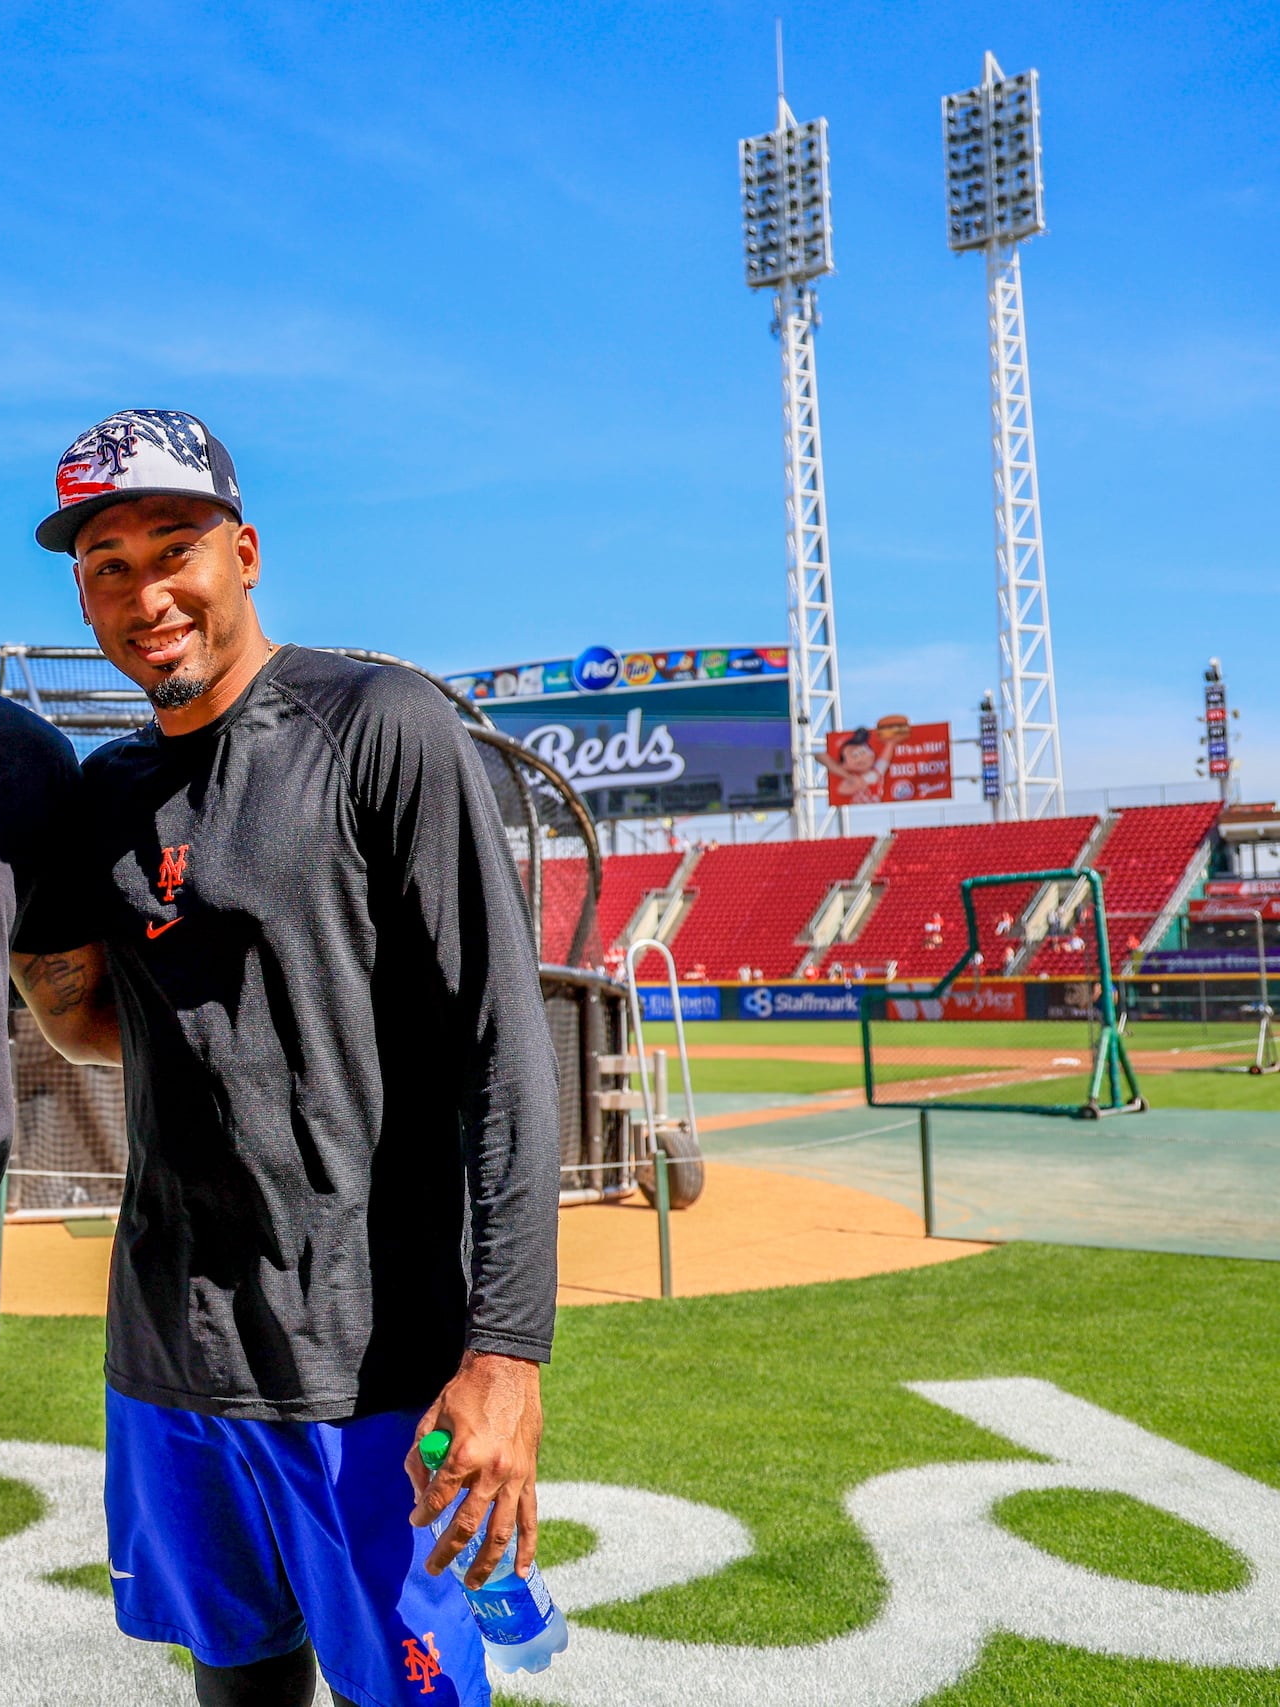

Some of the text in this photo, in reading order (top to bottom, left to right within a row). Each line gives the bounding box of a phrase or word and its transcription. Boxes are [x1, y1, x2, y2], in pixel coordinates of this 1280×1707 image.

[581, 658, 618, 680] P&G
[626, 663, 651, 680] Tide
[521, 707, 685, 798] Reds
[889, 760, 948, 777] BIG BOY
[774, 993, 859, 1013] Staffmark
